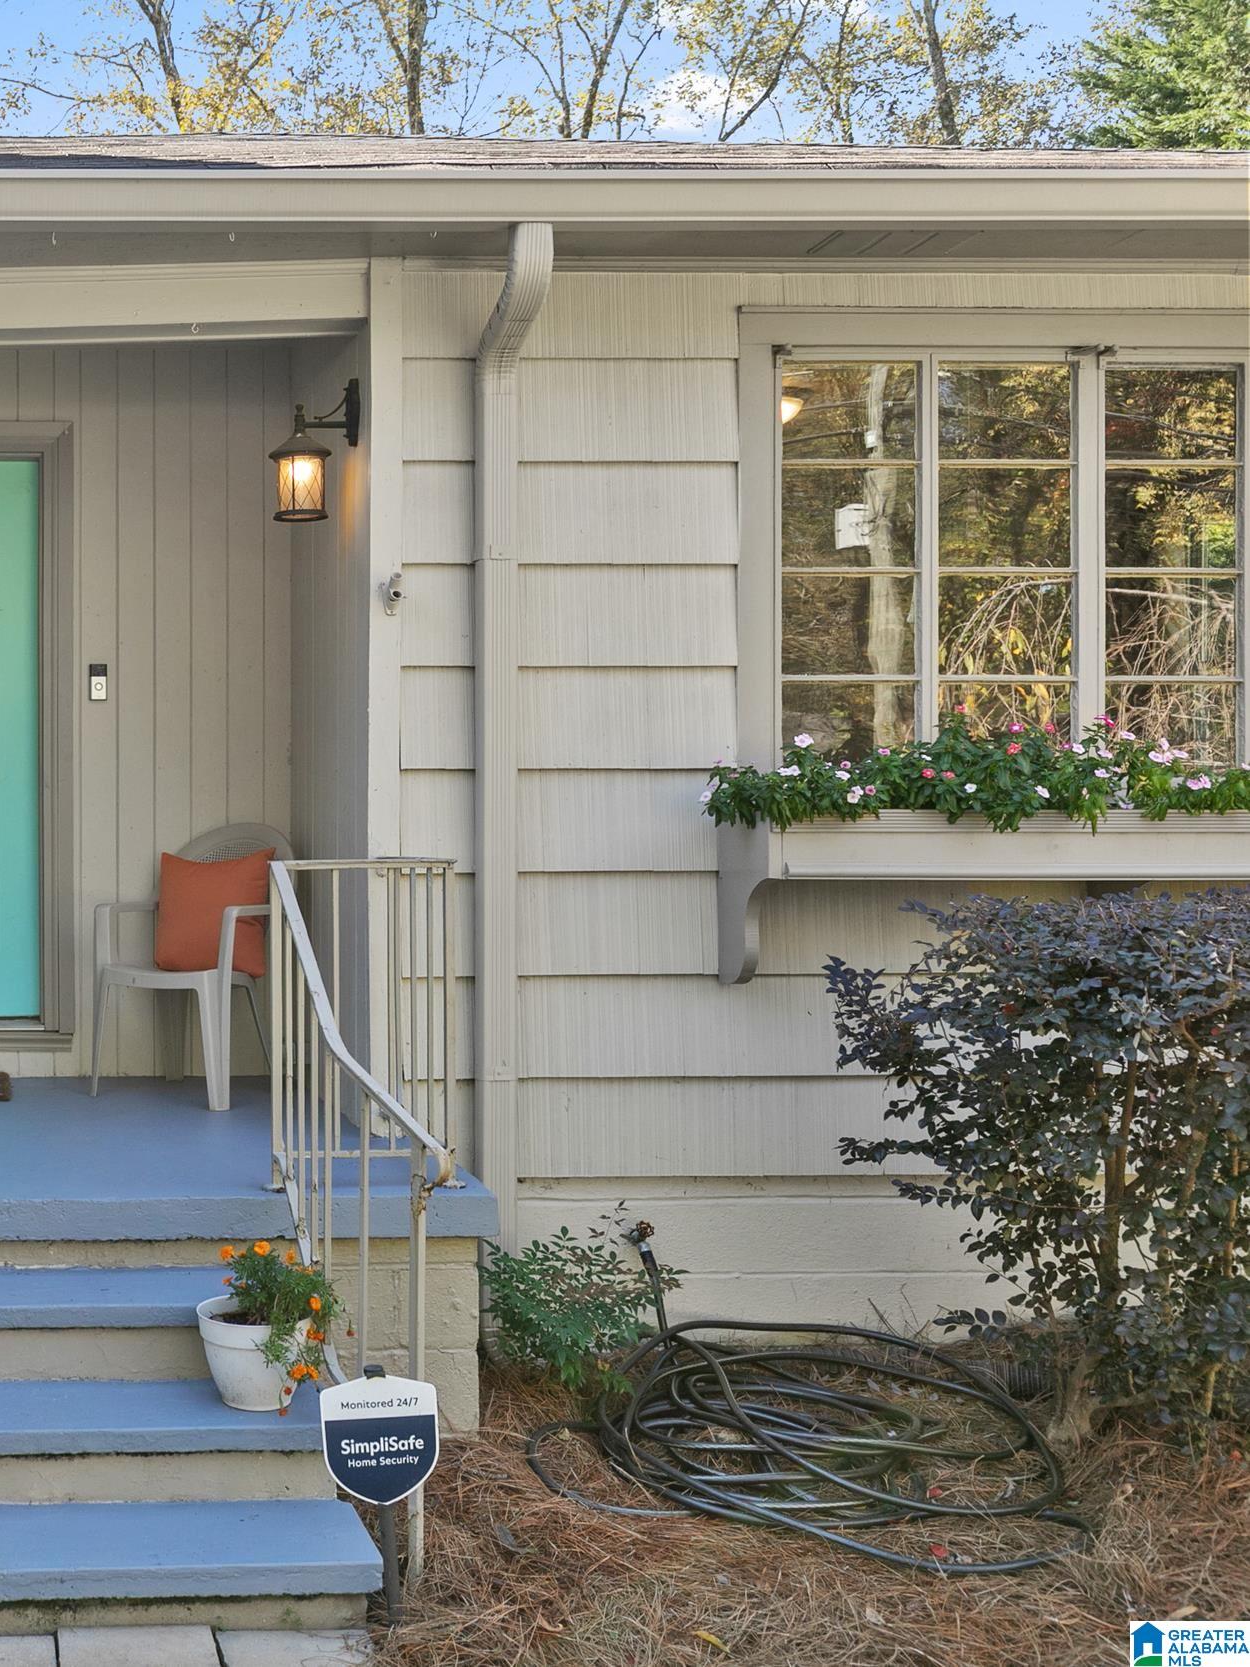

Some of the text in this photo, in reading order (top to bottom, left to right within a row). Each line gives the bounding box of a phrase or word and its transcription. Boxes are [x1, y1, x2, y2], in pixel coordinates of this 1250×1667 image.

[340, 1397, 419, 1410] Monitored 24/7
[340, 1435, 425, 1456] SimpliSafe
[347, 1455, 420, 1468] Home Security
